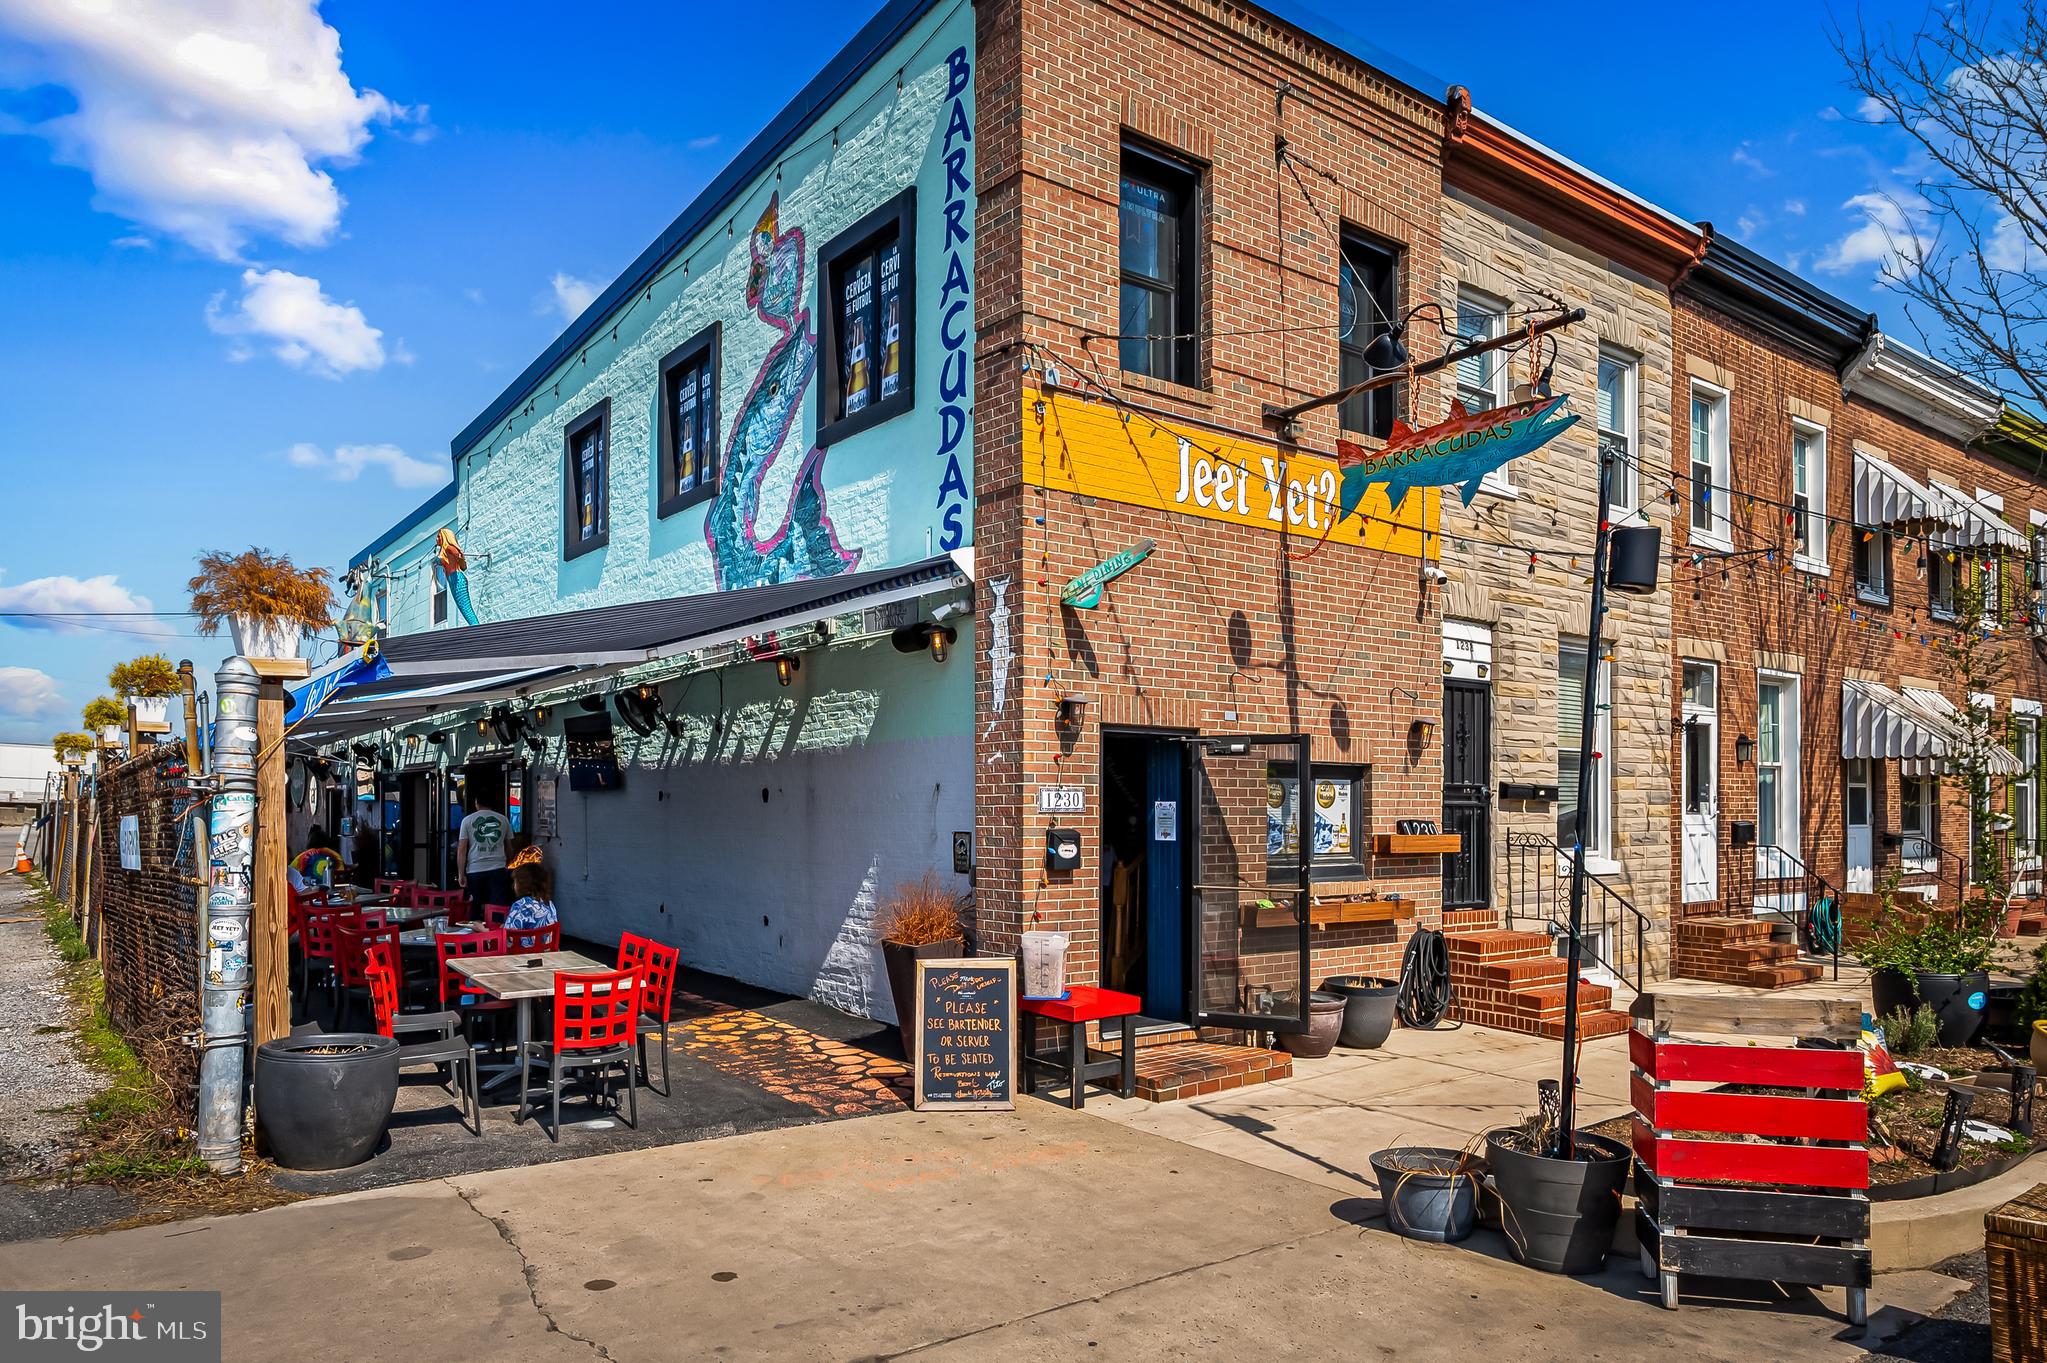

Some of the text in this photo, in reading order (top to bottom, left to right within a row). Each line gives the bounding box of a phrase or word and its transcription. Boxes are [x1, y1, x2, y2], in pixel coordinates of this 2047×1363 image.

[1137, 185, 1166, 203] ULTRA
[845, 271, 872, 301] CERVEZA
[936, 45, 972, 551] BARRACUDAS
[1364, 420, 1514, 476] BARRACUDAS
[1175, 436, 1336, 531] Jeet Yet?
[1093, 551, 1133, 581] DINING
[1047, 792, 1080, 808] 1230
[929, 971, 959, 989] PLEASE
[945, 1001, 988, 1014] PLEASE
[927, 1018, 1002, 1031] SEE BARTENDER
[940, 1035, 991, 1047] OR SERVER
[927, 1053, 995, 1065] TO BE SEATED
